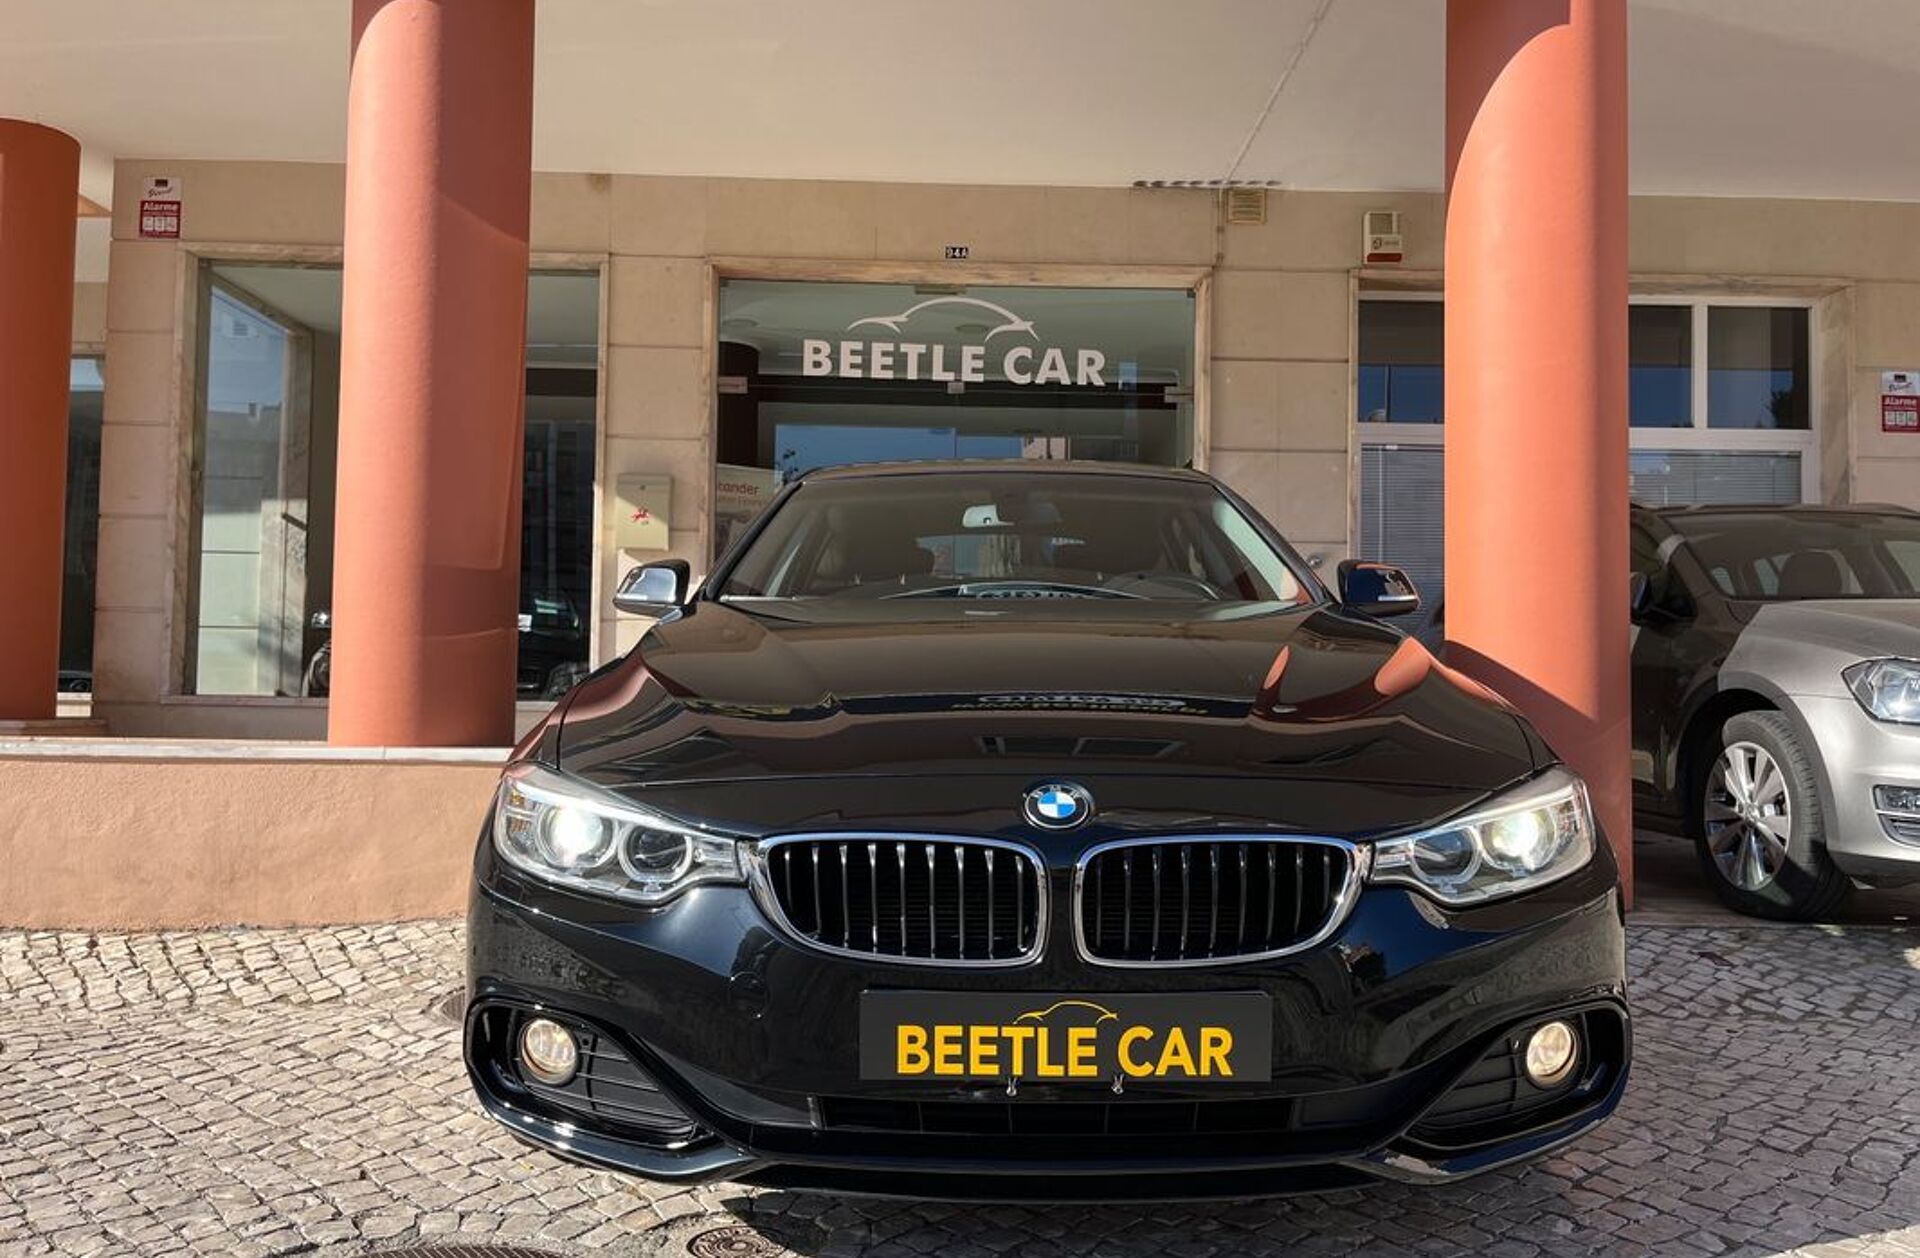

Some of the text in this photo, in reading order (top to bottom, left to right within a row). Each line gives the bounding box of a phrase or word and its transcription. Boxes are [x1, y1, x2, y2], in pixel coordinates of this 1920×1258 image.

[143, 202, 178, 211] Alarme
[803, 339, 1106, 386] BEETLE CAR
[896, 1025, 1233, 1077] BEETLE CAR
